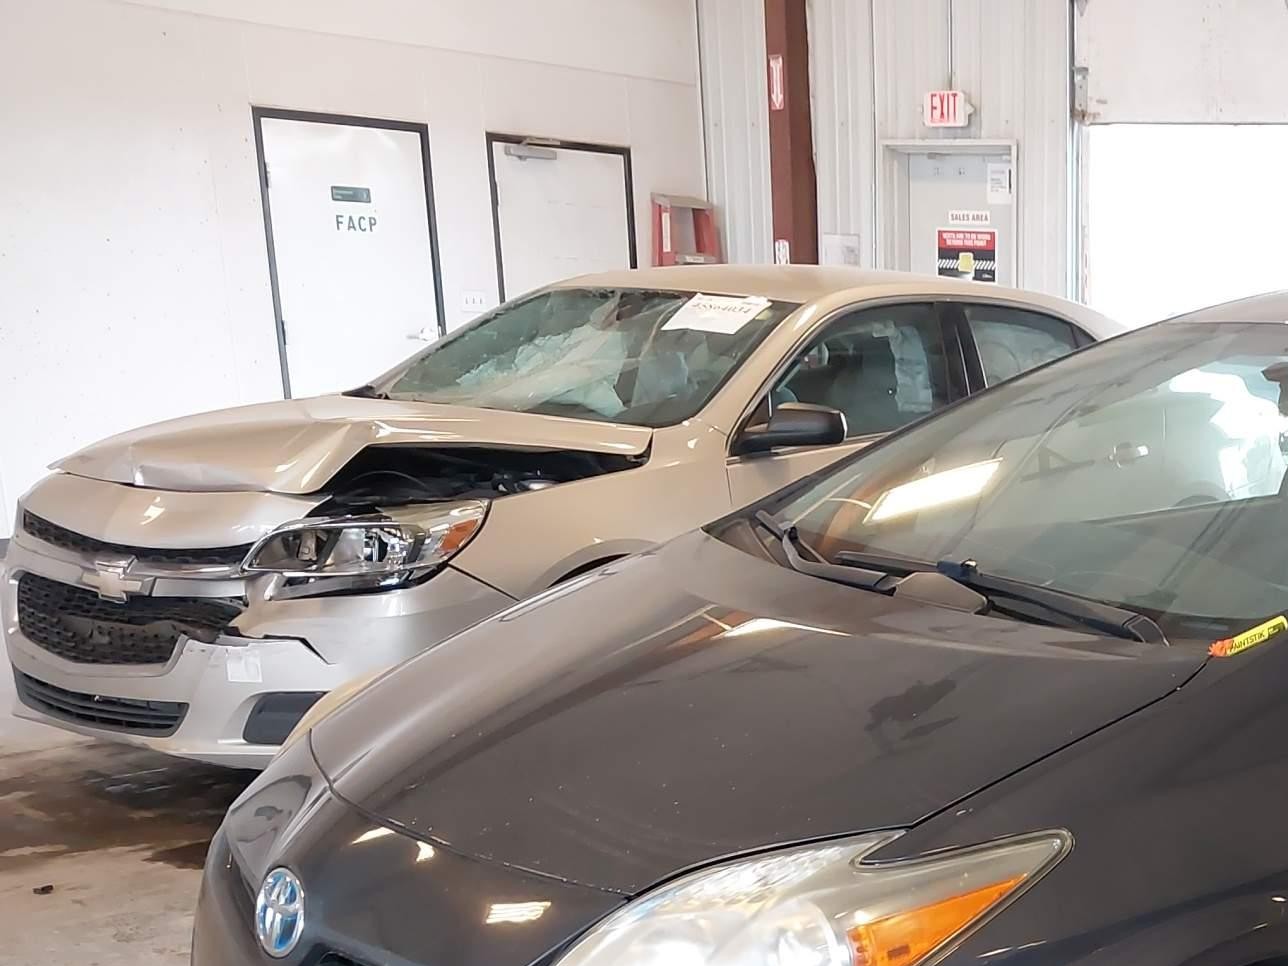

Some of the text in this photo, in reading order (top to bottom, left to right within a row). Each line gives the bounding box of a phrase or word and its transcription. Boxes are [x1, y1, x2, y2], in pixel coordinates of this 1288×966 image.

[930, 93, 958, 122] EXIT
[335, 214, 377, 232] FACP
[950, 213, 989, 222] SALES AREA
